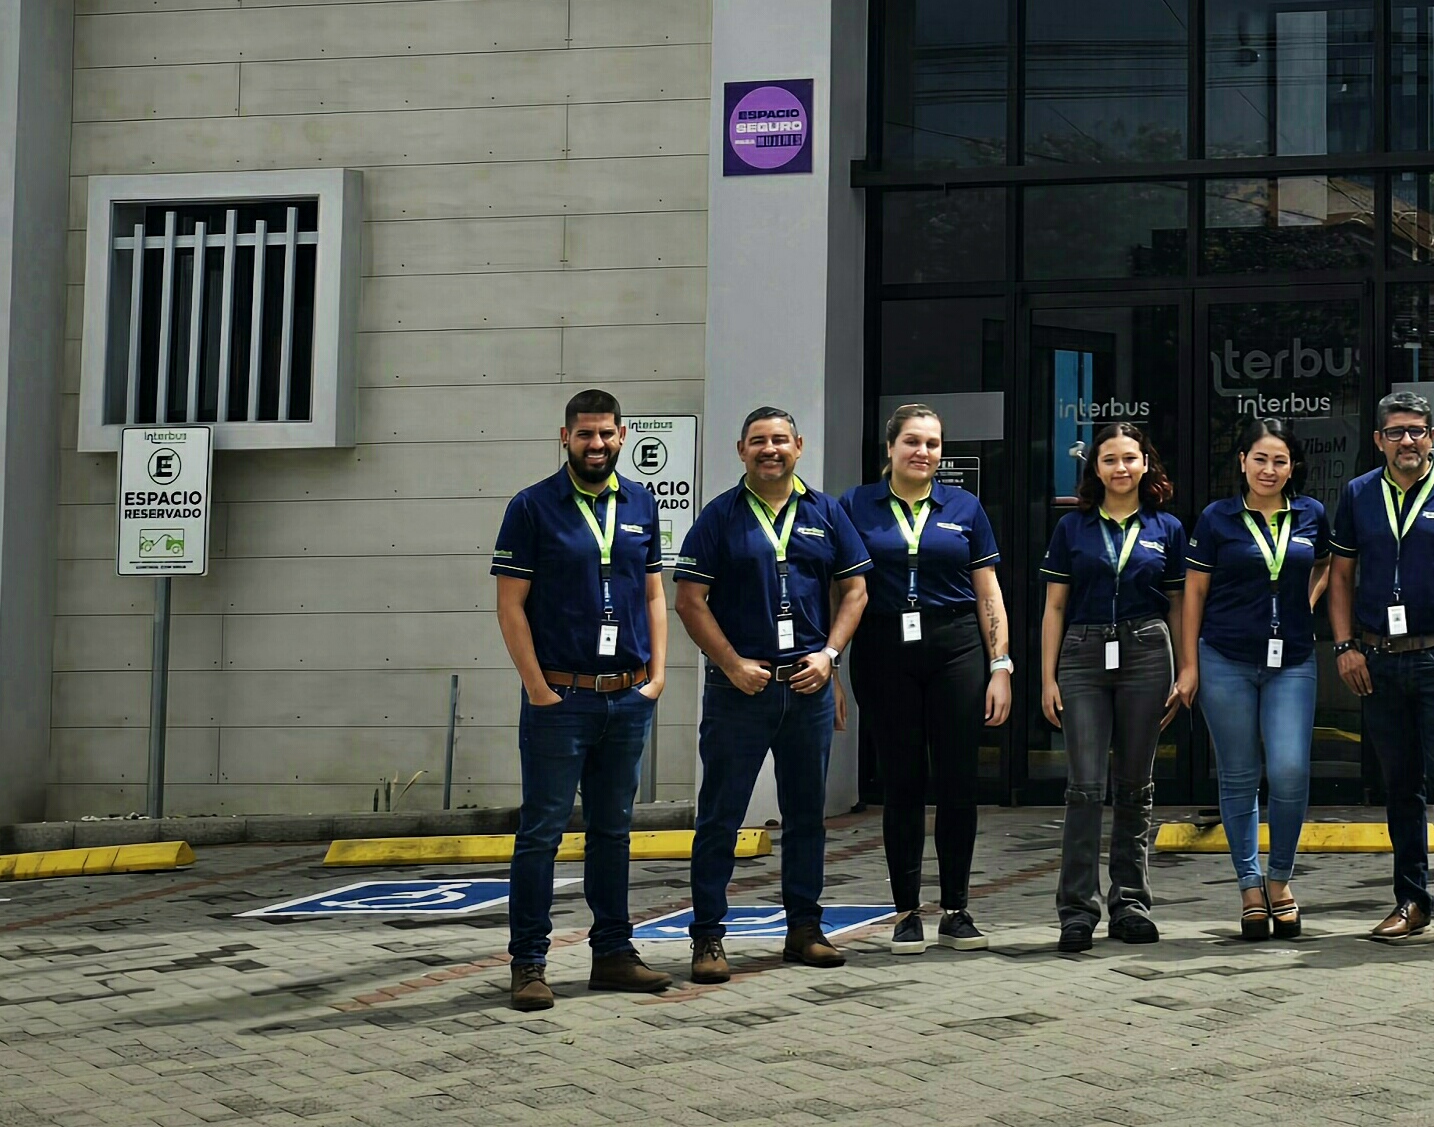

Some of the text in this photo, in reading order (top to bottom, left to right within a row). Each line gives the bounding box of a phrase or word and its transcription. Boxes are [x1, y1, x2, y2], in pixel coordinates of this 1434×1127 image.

[738, 109, 800, 120] ESPACIO
[736, 121, 802, 133] SEGURO
[1059, 397, 1150, 423] interbus
[1237, 393, 1331, 419] interbus
[125, 491, 202, 505] ESPACIO
[125, 508, 202, 519] RESERVADO
